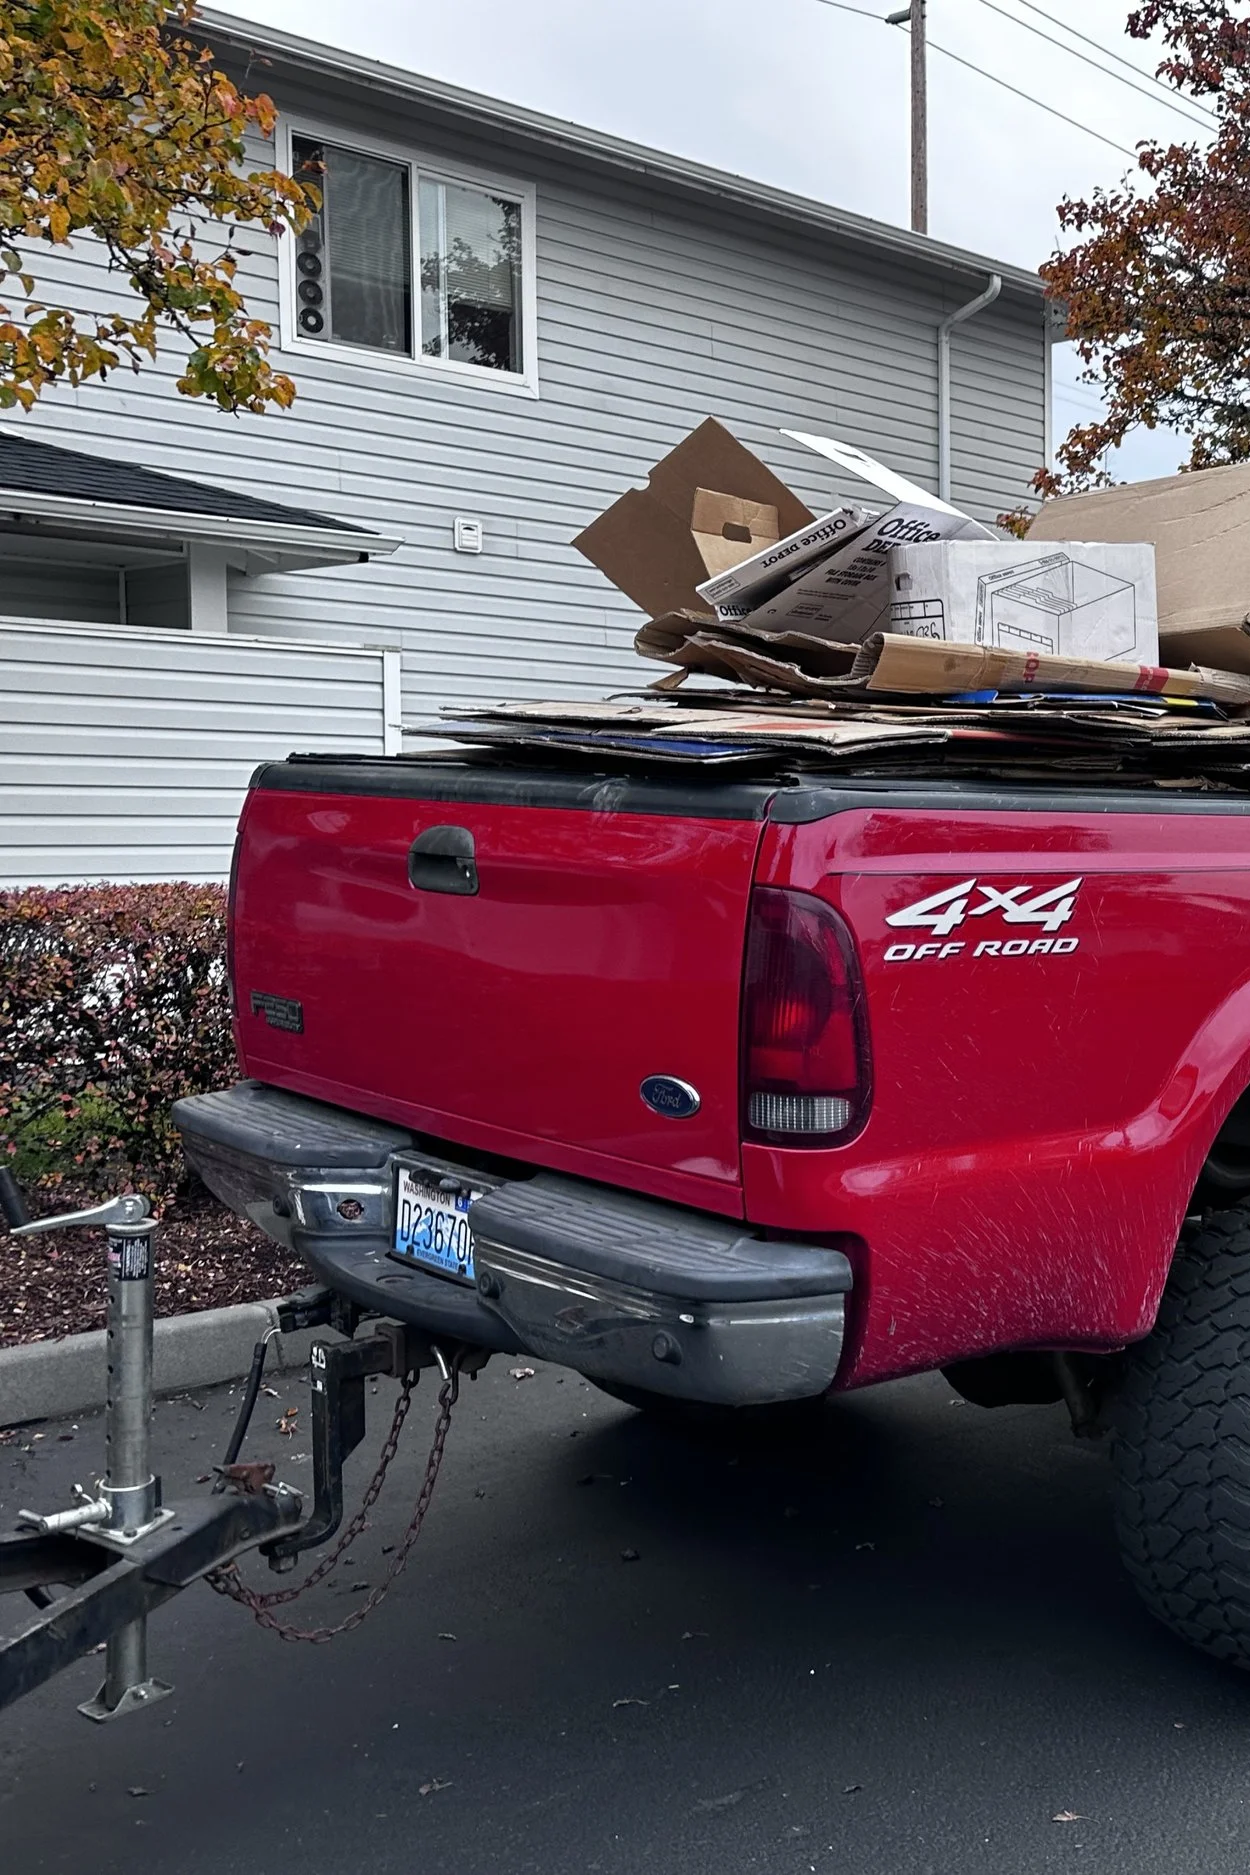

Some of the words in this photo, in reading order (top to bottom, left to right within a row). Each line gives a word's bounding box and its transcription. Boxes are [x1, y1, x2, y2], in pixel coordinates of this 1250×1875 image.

[800, 518, 847, 546] Office
[877, 518, 941, 543] Office
[762, 544, 800, 568] DEPOT
[883, 942, 966, 962] OFF
[972, 937, 1080, 958] ROAD
[652, 1083, 681, 1109] Ford
[403, 1180, 451, 1206] WASHINGTON
